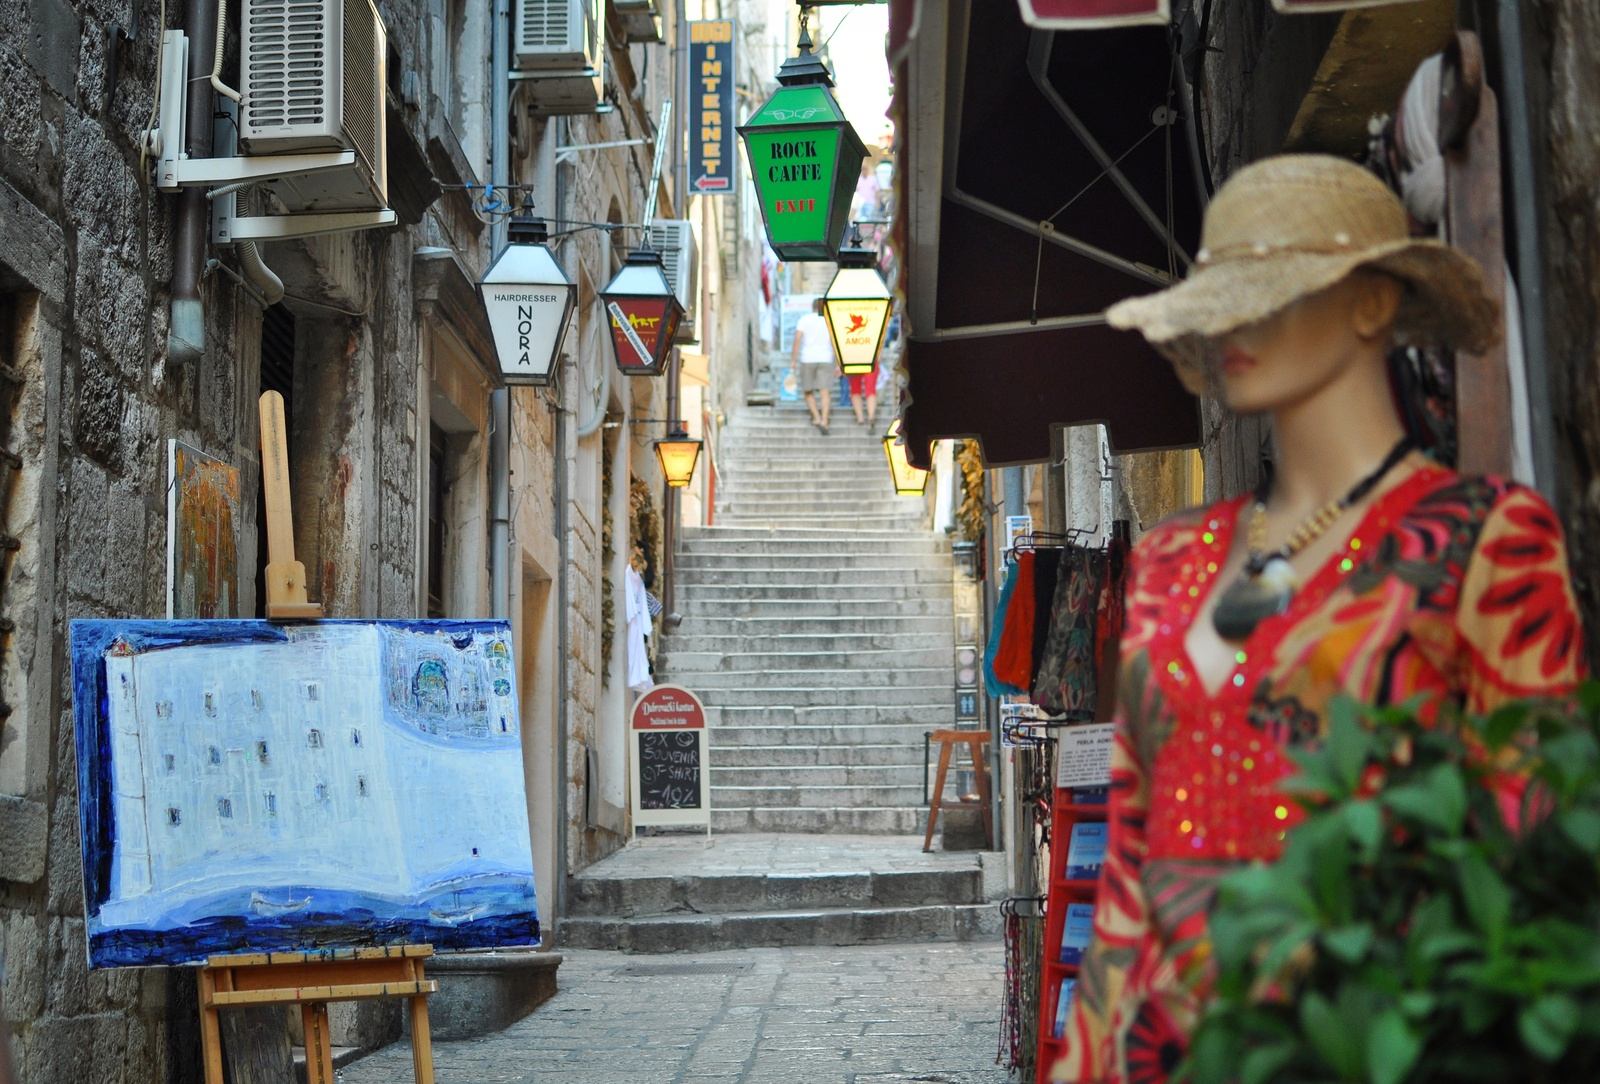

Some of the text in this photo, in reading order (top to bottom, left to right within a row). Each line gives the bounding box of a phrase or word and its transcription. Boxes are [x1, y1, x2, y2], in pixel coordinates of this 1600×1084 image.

[702, 45, 722, 175] INTERNET
[771, 141, 817, 160] ROCK
[768, 163, 821, 183] CAFFE
[775, 199, 816, 213] EXIT
[494, 294, 557, 303] HAIRDRESSER
[518, 305, 533, 366] NORA
[845, 337, 871, 345] AMOR
[643, 747, 699, 765] SOUVENIR
[648, 784, 694, 804] -10%
